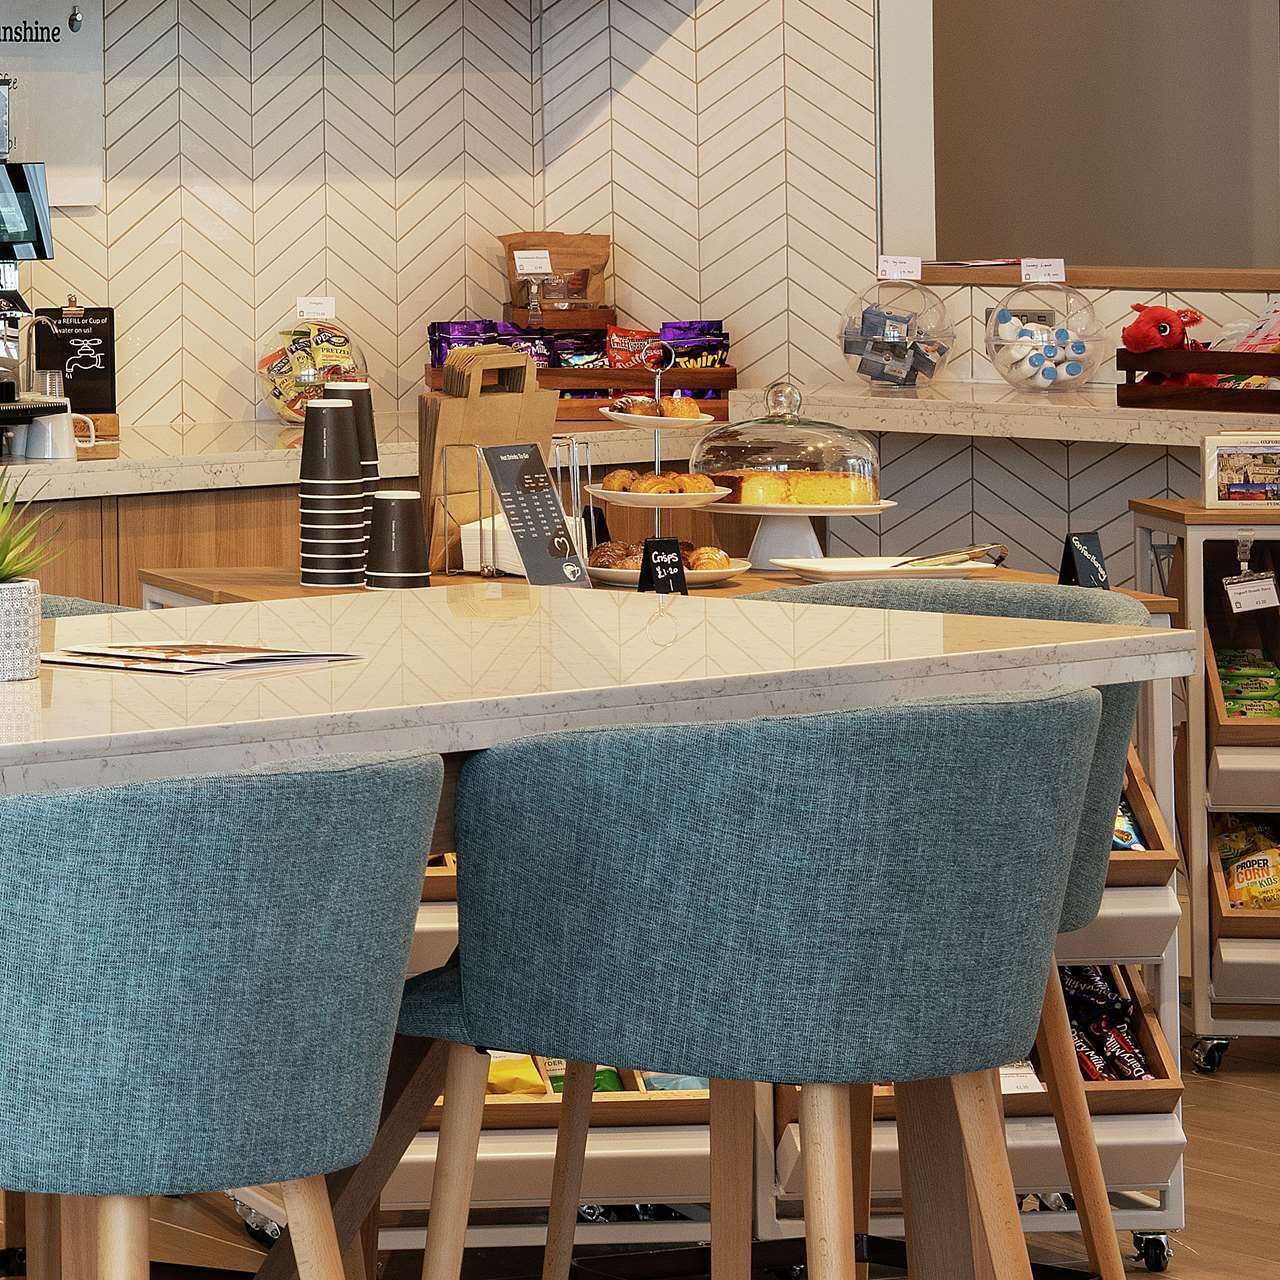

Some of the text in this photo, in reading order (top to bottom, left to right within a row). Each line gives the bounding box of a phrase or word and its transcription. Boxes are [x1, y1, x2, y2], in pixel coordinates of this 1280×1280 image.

[532, 346, 549, 355] Milk
[651, 550, 679, 565] Crisps
[1071, 536, 1107, 582] Confectionery
[1236, 858, 1269, 872] PROPER
[1237, 867, 1270, 883] CORN
[1086, 1050, 1104, 1072] Milk
[1106, 1033, 1144, 1076] Dairy Milk
